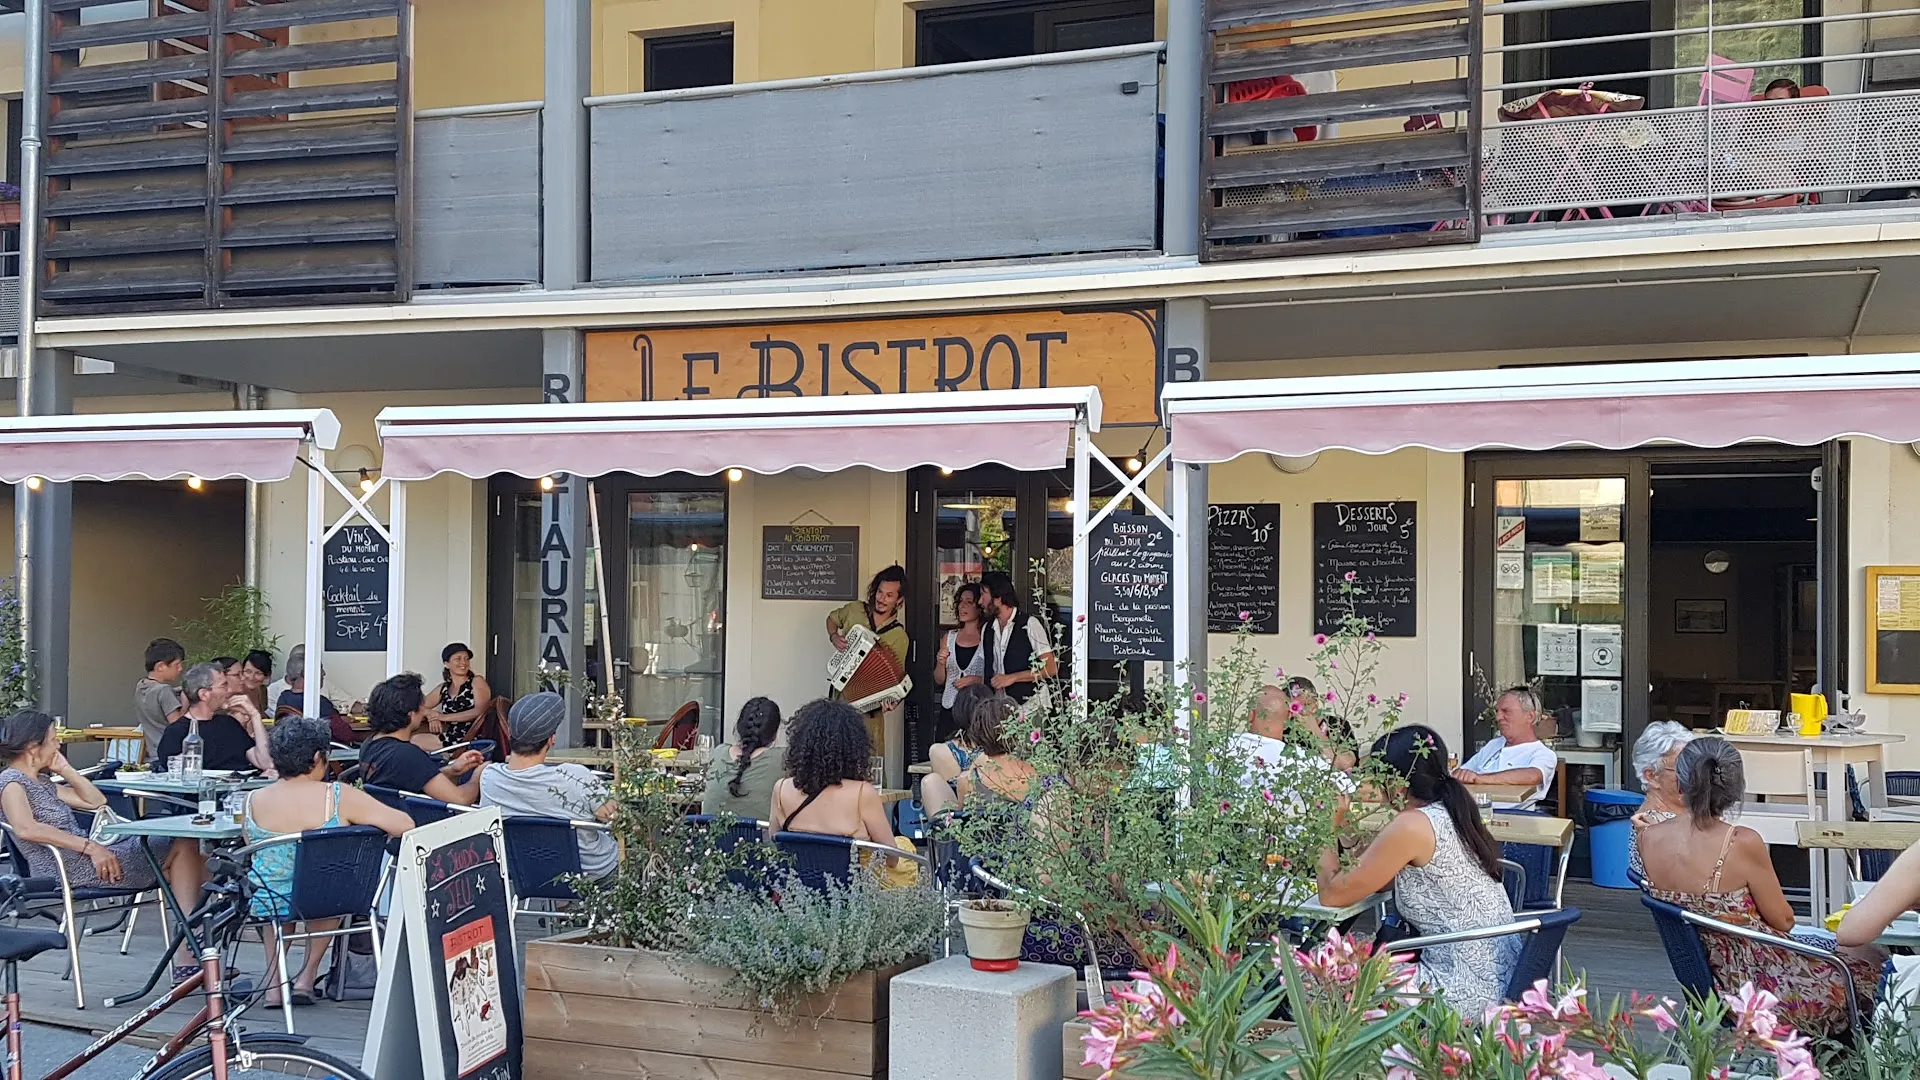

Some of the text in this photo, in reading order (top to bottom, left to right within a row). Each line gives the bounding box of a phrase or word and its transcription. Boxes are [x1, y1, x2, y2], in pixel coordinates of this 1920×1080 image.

[737, 331, 1068, 397] BISTROT
[1119, 534, 1142, 547] JOUR
[1101, 571, 1130, 583] GLACES
[1118, 601, 1129, 611] de
[1132, 601, 1141, 611] la
[1113, 644, 1155, 656] Pistache
